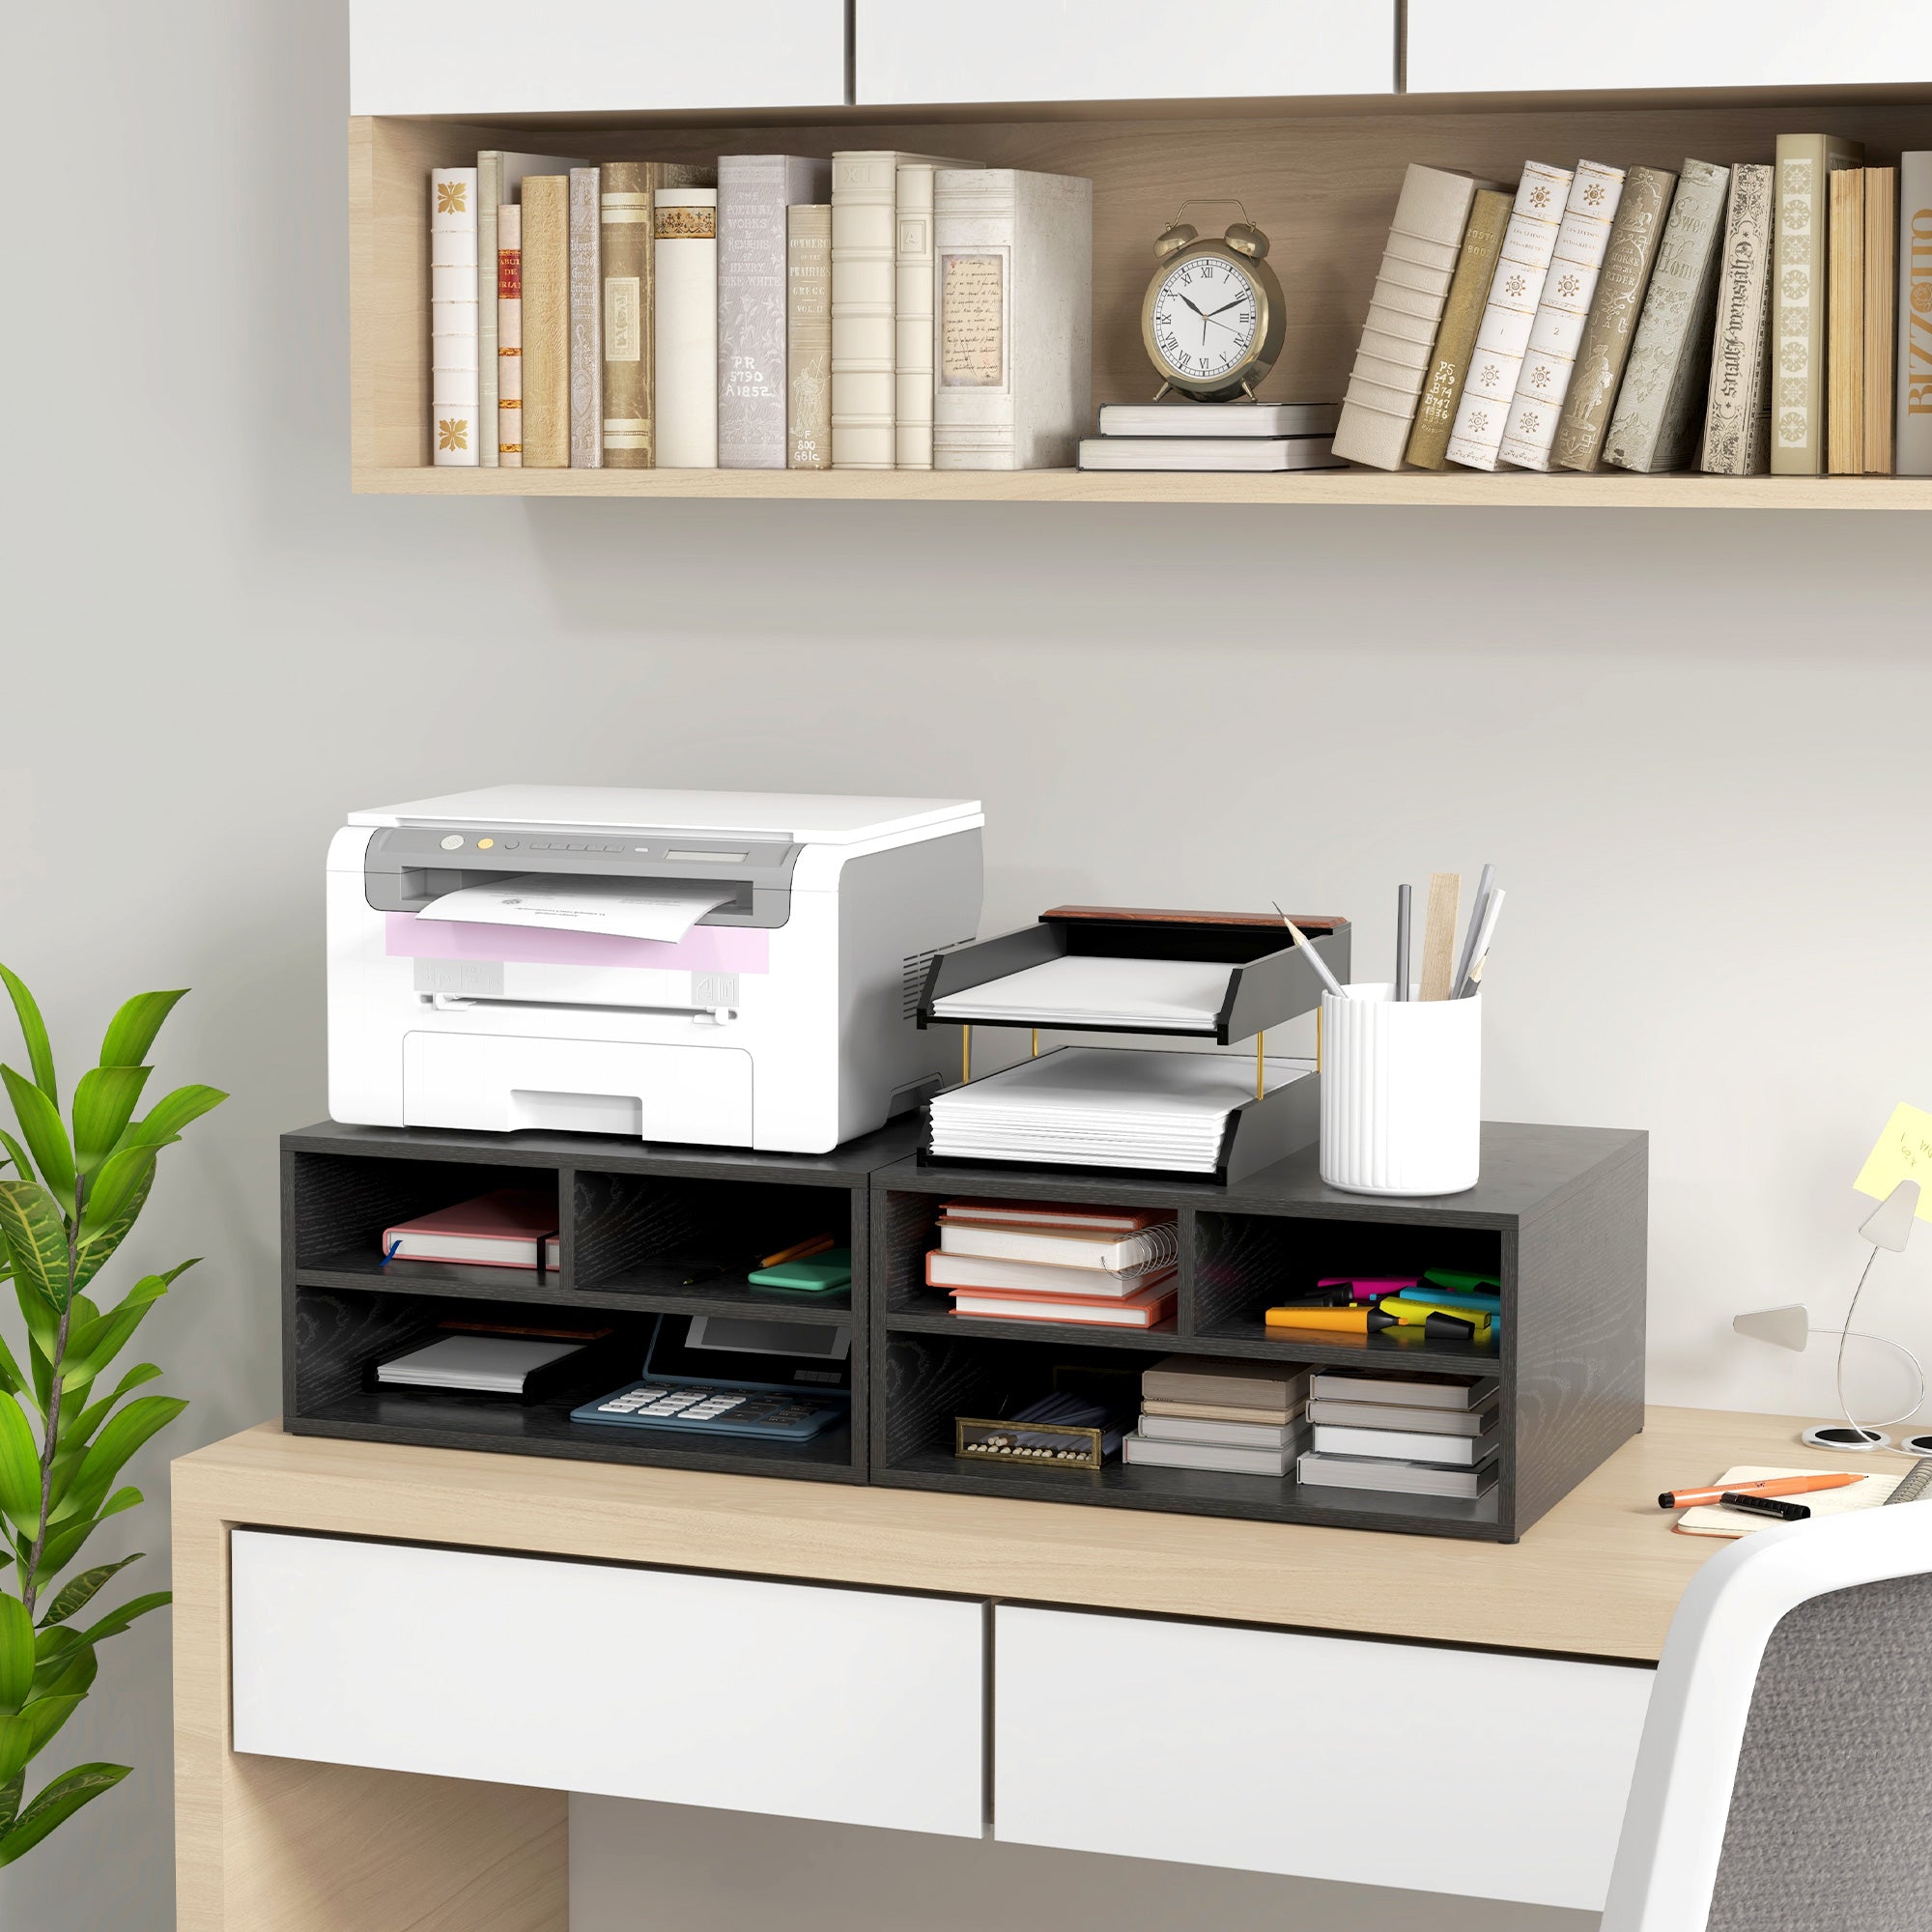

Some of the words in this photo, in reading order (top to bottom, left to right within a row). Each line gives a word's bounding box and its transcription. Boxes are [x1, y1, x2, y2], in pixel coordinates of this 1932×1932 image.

[727, 218, 767, 229] WORKS
[1611, 252, 1639, 267] HORSE
[730, 262, 766, 272] HENRY
[1201, 268, 1213, 278] XII
[1181, 273, 1193, 287] XI
[1223, 274, 1230, 284] I
[1605, 271, 1634, 286] RIDER
[1167, 290, 1179, 301] X
[1235, 291, 1245, 300] II
[1162, 314, 1172, 325] IX
[1239, 313, 1249, 323] III
[1165, 331, 1179, 351] VIII
[1234, 332, 1244, 347] IV
[731, 355, 755, 369] PR
[1179, 350, 1192, 365] VII
[1219, 351, 1227, 362] V
[1199, 357, 1209, 369] VI
[1439, 360, 1455, 375] PS
[730, 371, 763, 383] 5790
[725, 384, 775, 397] A1852
[1424, 393, 1450, 409] B747
[805, 430, 811, 439] F
[798, 440, 816, 450] 800
